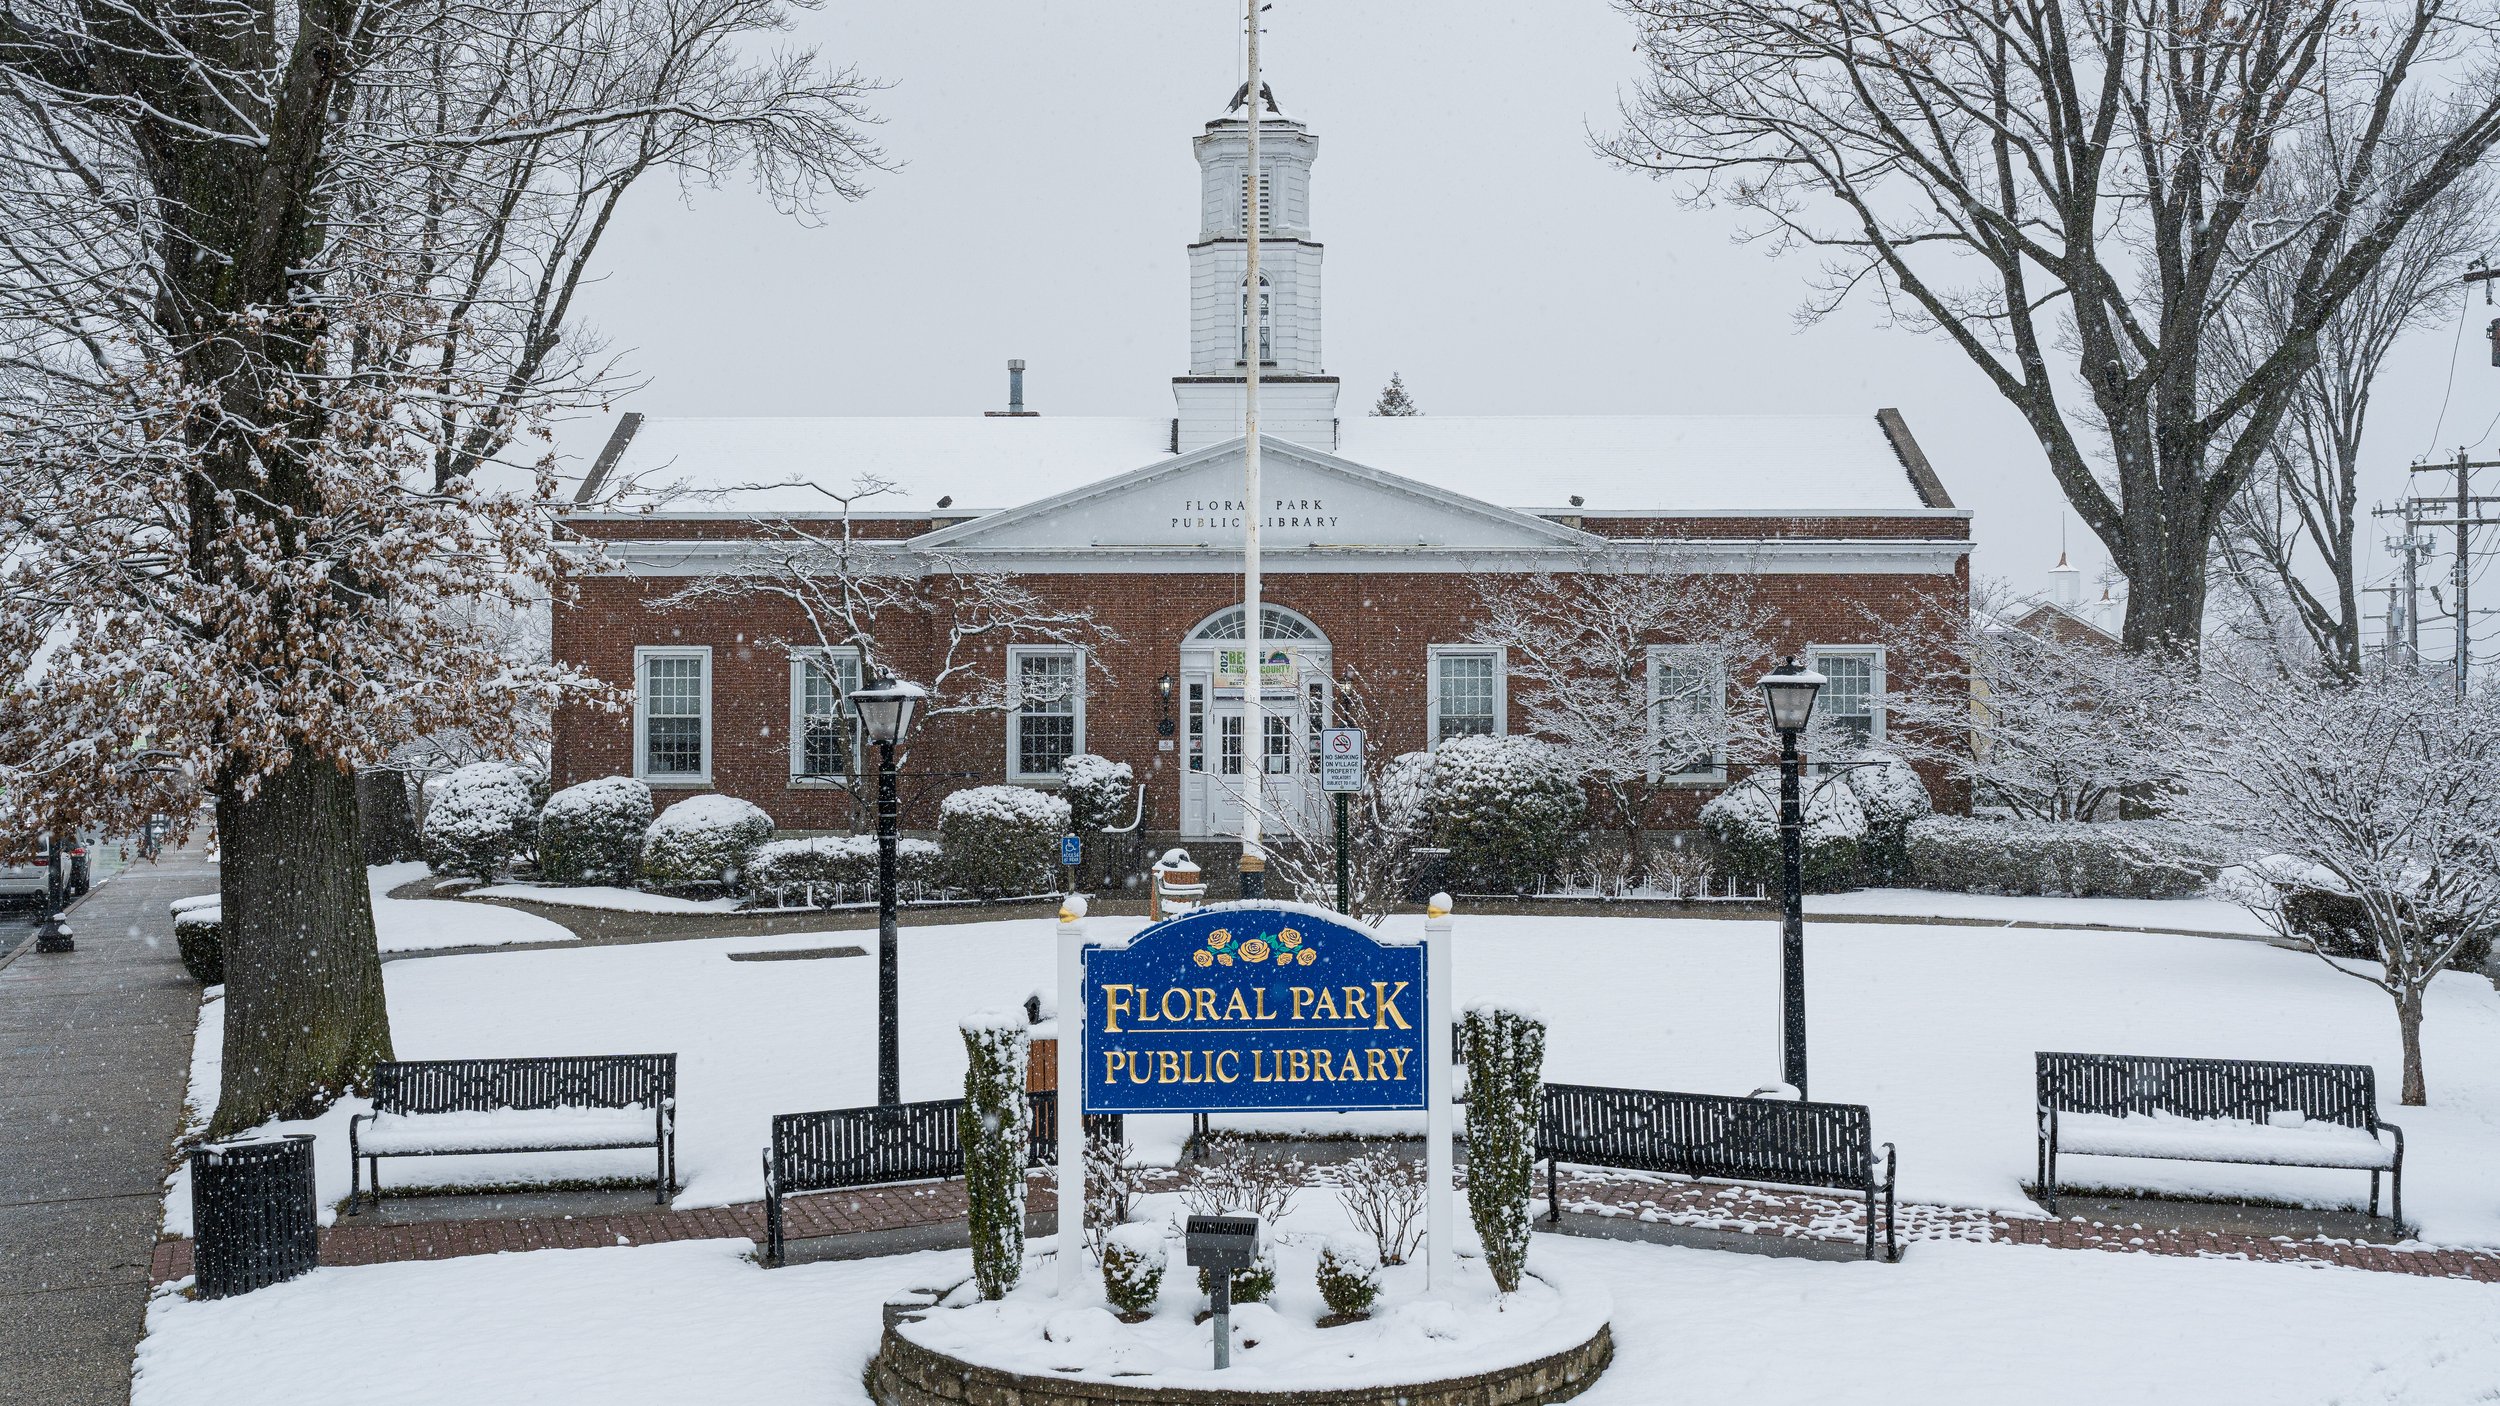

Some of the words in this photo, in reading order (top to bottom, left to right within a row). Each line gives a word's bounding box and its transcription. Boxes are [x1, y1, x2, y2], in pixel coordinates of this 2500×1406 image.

[1186, 500, 1246, 511] FLORA
[1276, 499, 1323, 510] PARK
[1172, 517, 1240, 528] PUBLIC
[1220, 651, 1228, 673] 2021
[1260, 665, 1290, 674] COUNTY
[1101, 984, 1277, 1033] FLORAL
[1289, 981, 1412, 1031] PARK
[1104, 1050, 1240, 1084] PUBLIC
[1251, 1048, 1413, 1082] LIBRARY
